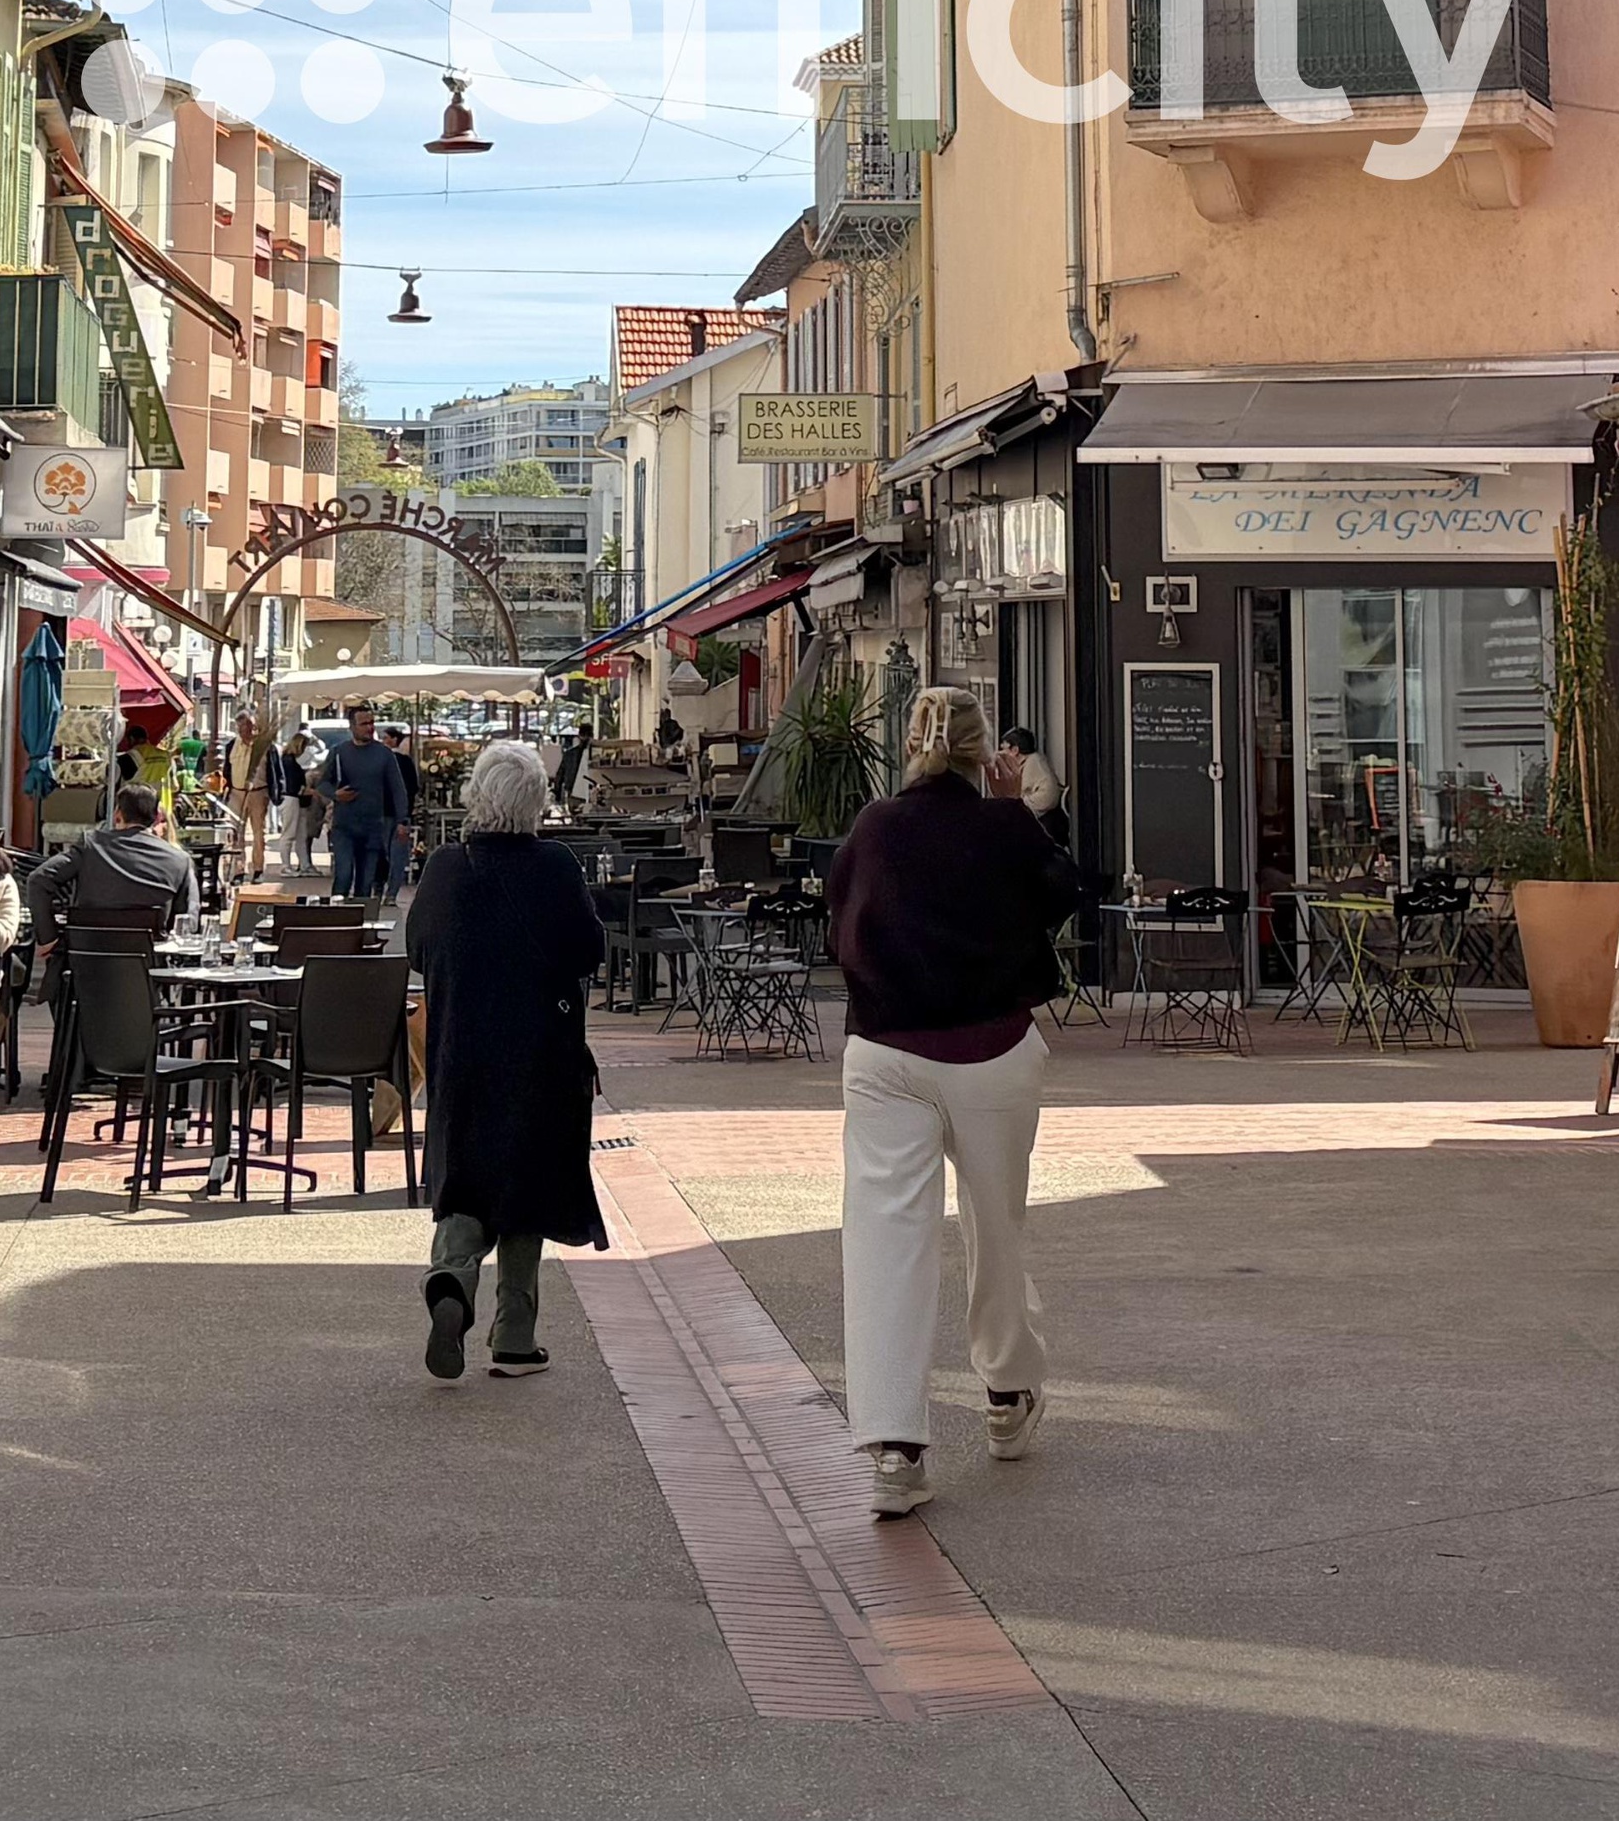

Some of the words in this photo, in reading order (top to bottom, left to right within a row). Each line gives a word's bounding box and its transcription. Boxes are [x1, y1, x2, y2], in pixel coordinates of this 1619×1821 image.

[755, 400, 858, 418] BRASSERIE
[747, 422, 784, 440] DES
[791, 422, 862, 440] HALLES
[1235, 509, 1314, 533] DEI
[1336, 508, 1544, 541] GAGNENC
